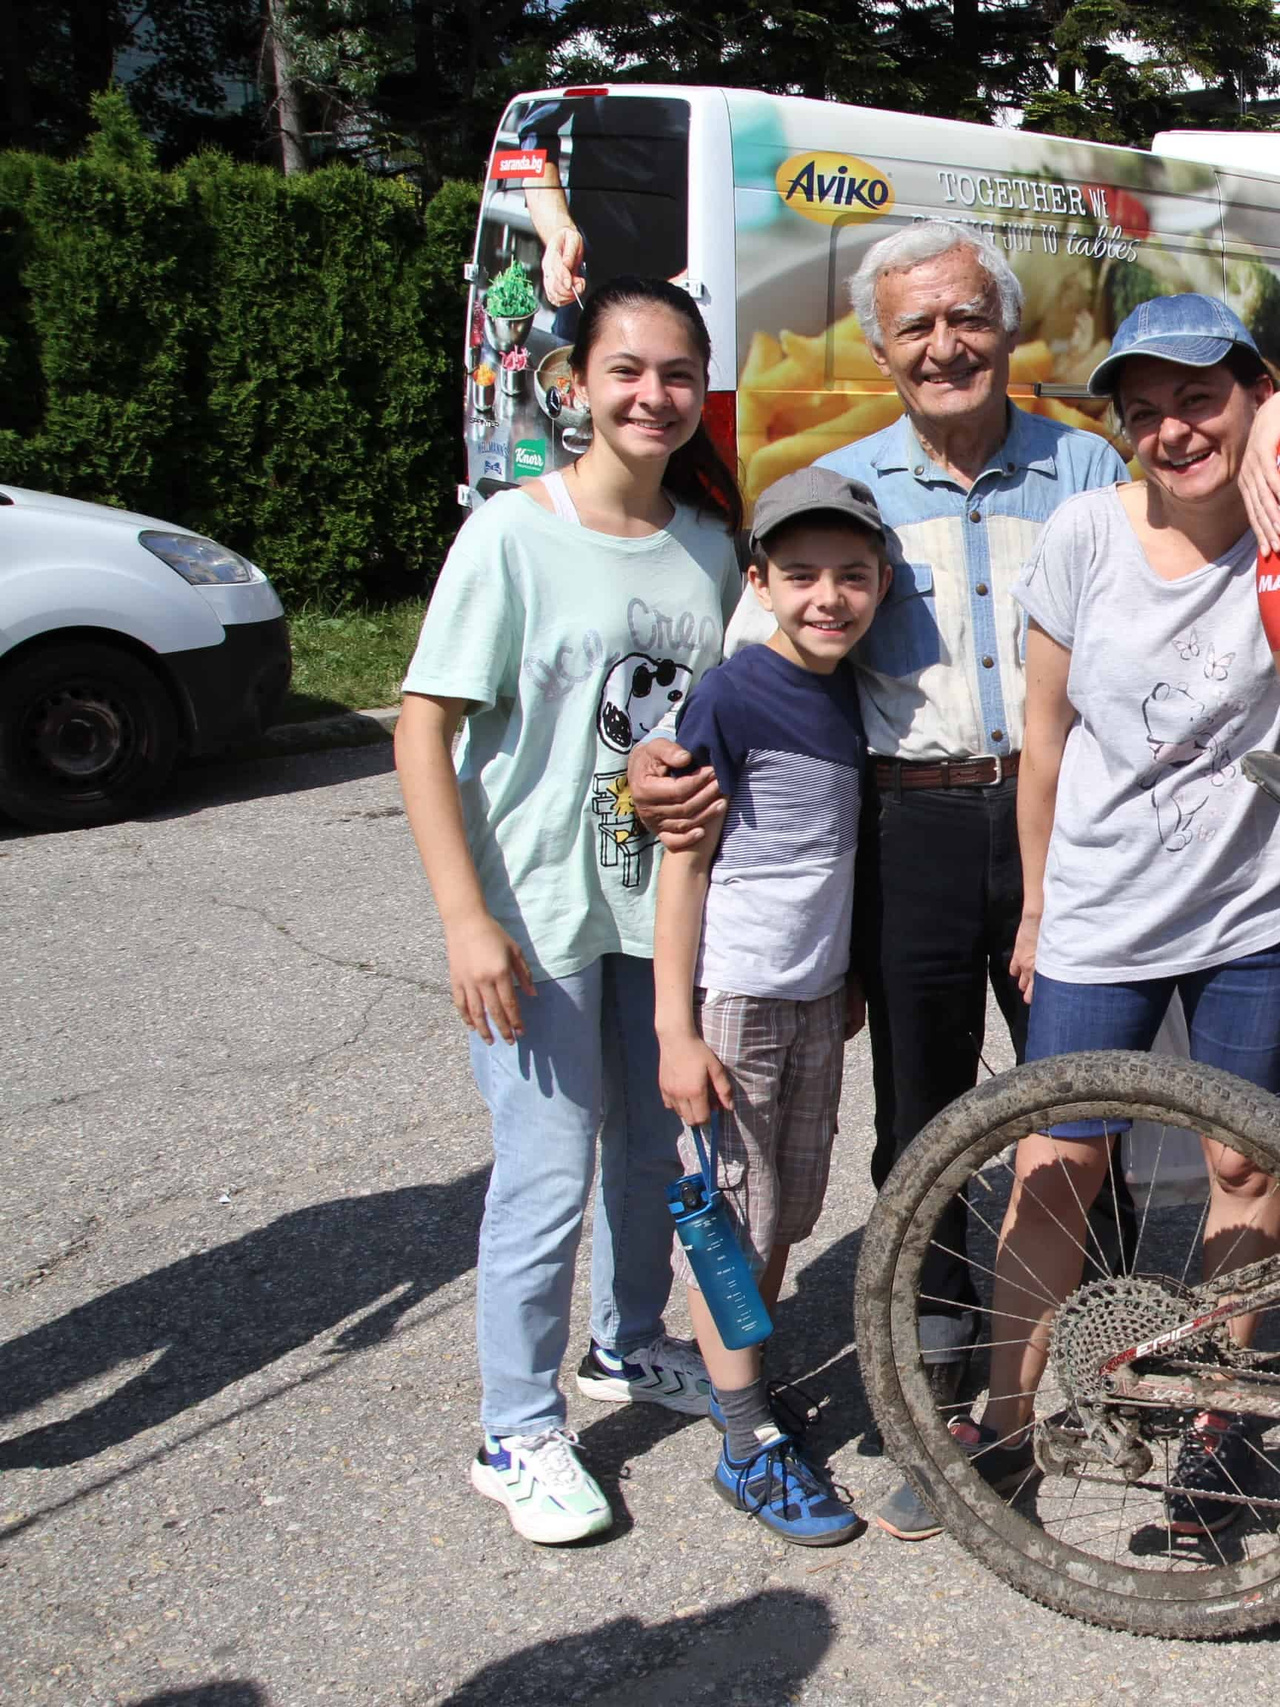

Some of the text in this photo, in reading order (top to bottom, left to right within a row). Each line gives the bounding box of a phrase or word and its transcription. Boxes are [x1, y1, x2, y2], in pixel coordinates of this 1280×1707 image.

[499, 155, 543, 174] saranda.bg
[785, 160, 889, 211] Aviko
[937, 170, 1110, 219] TOGETHER WE
[1002, 221, 1034, 253] JOY
[1042, 223, 1058, 254] TO
[1066, 225, 1143, 263] tables
[514, 447, 544, 467] Knorr
[1136, 1322, 1195, 1358] EPIC
